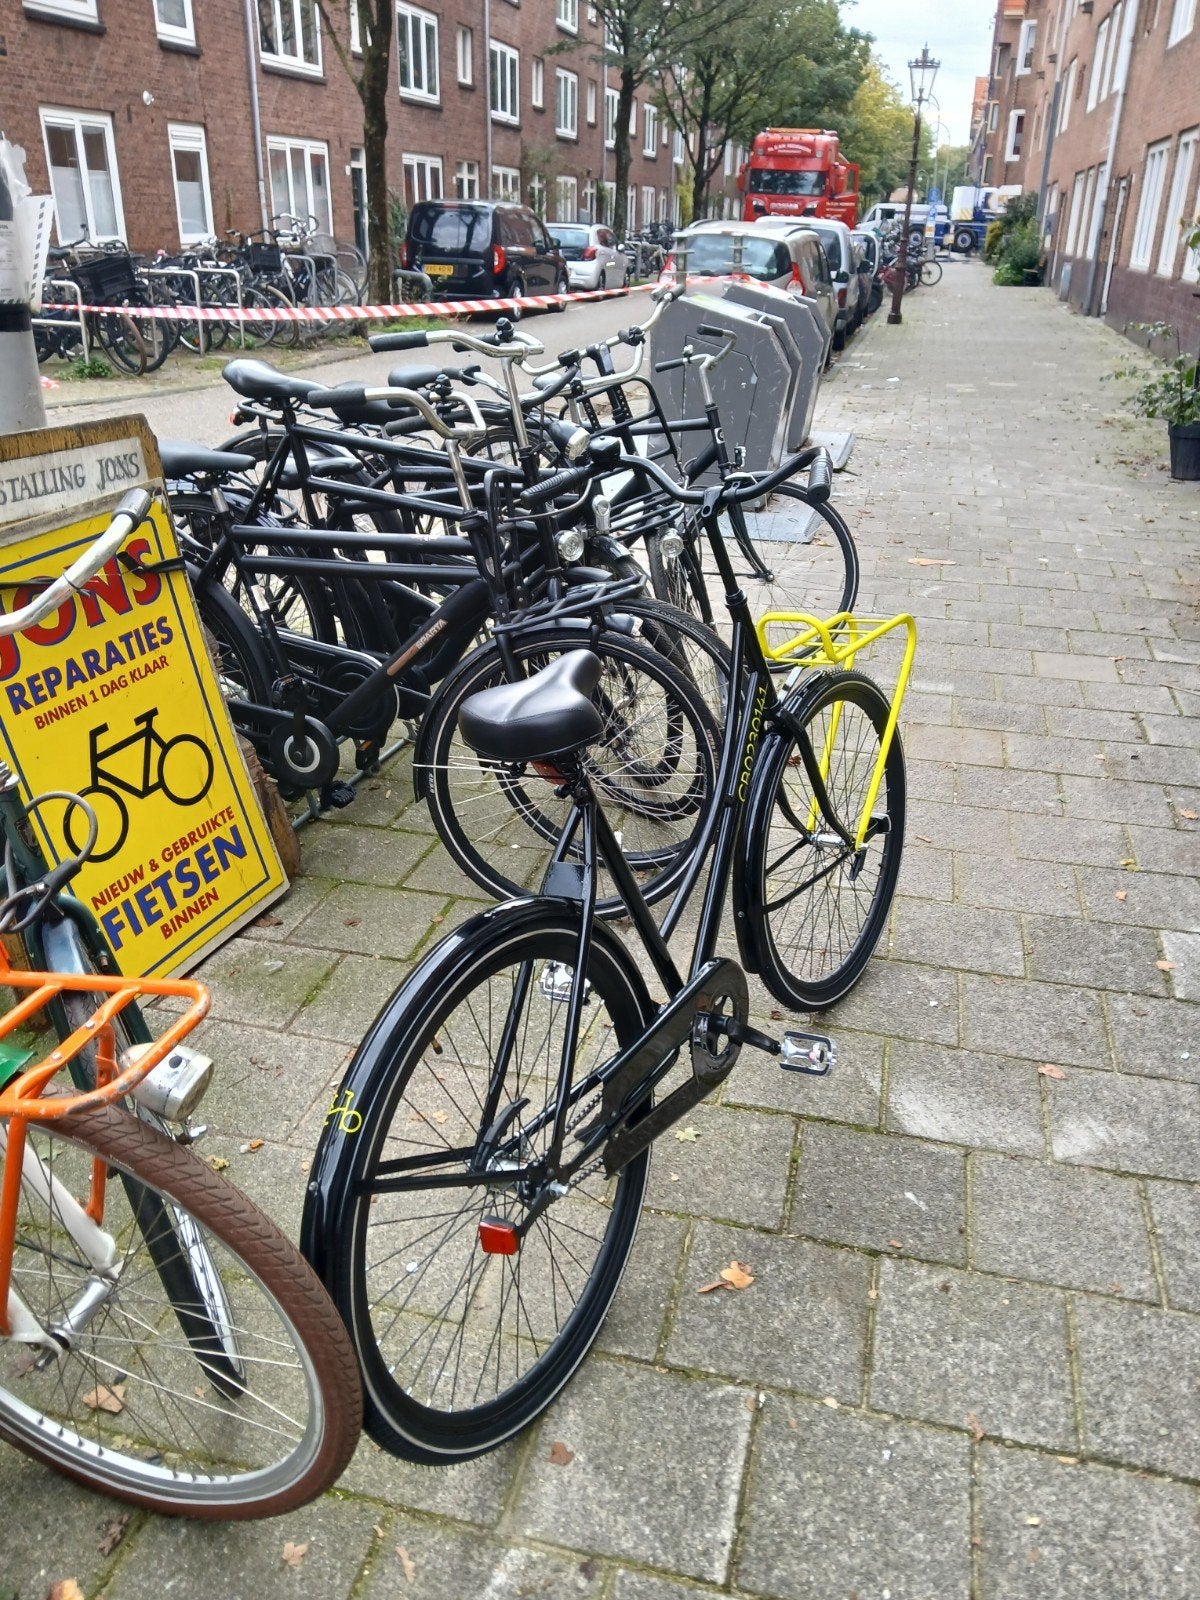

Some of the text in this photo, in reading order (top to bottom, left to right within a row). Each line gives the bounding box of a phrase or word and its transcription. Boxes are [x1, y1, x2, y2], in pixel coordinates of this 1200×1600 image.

[96, 452, 141, 492] JONS
[5, 616, 174, 716] REPARATIES
[415, 619, 449, 650] SPARTA
[34, 655, 170, 730] BINNEN 1 DAG KLAAR
[91, 806, 235, 912] NIEUW & GEBRUIKTE
[100, 824, 248, 952] FIETSEN
[160, 887, 220, 941] BINNEN
